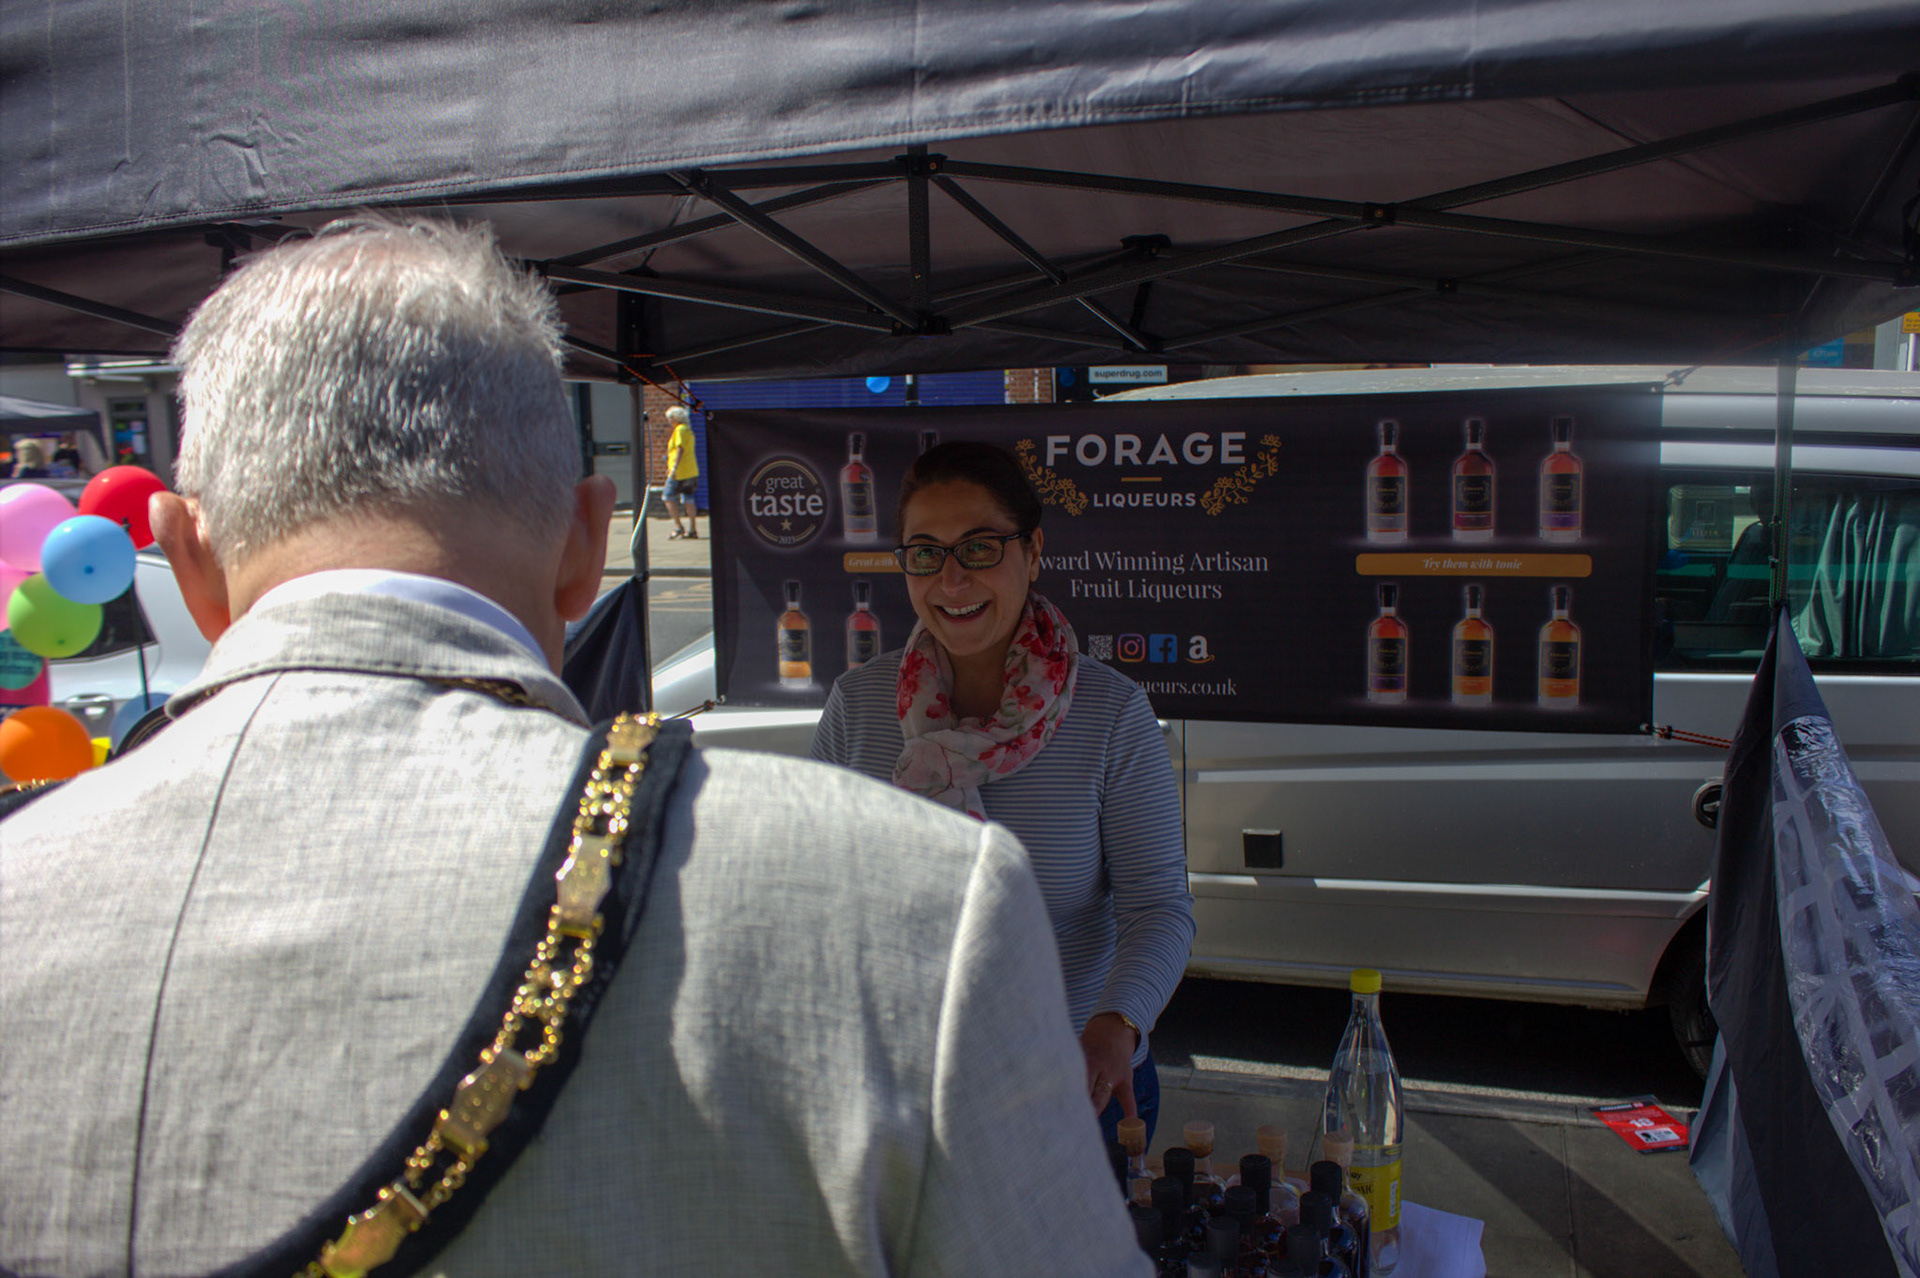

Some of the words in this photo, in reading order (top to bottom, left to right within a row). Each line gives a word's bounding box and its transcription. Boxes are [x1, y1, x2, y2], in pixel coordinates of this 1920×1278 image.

[1094, 369, 1162, 379] superdrug.com
[1046, 431, 1246, 467] FORAGE
[765, 475, 805, 494] great
[749, 492, 824, 516] taste
[1093, 492, 1197, 508] LIQUEURS
[1040, 550, 1090, 571] ward
[1095, 550, 1185, 575] Winning
[1190, 551, 1270, 572] Artisan
[1422, 557, 1441, 571] Try
[1442, 557, 1468, 569] them
[1470, 558, 1493, 569] with
[1496, 558, 1523, 569] tonic
[1070, 578, 1122, 598] Fruit
[1128, 578, 1223, 602] Liqueurs
[1139, 678, 1238, 697] ueurs.co.uk
